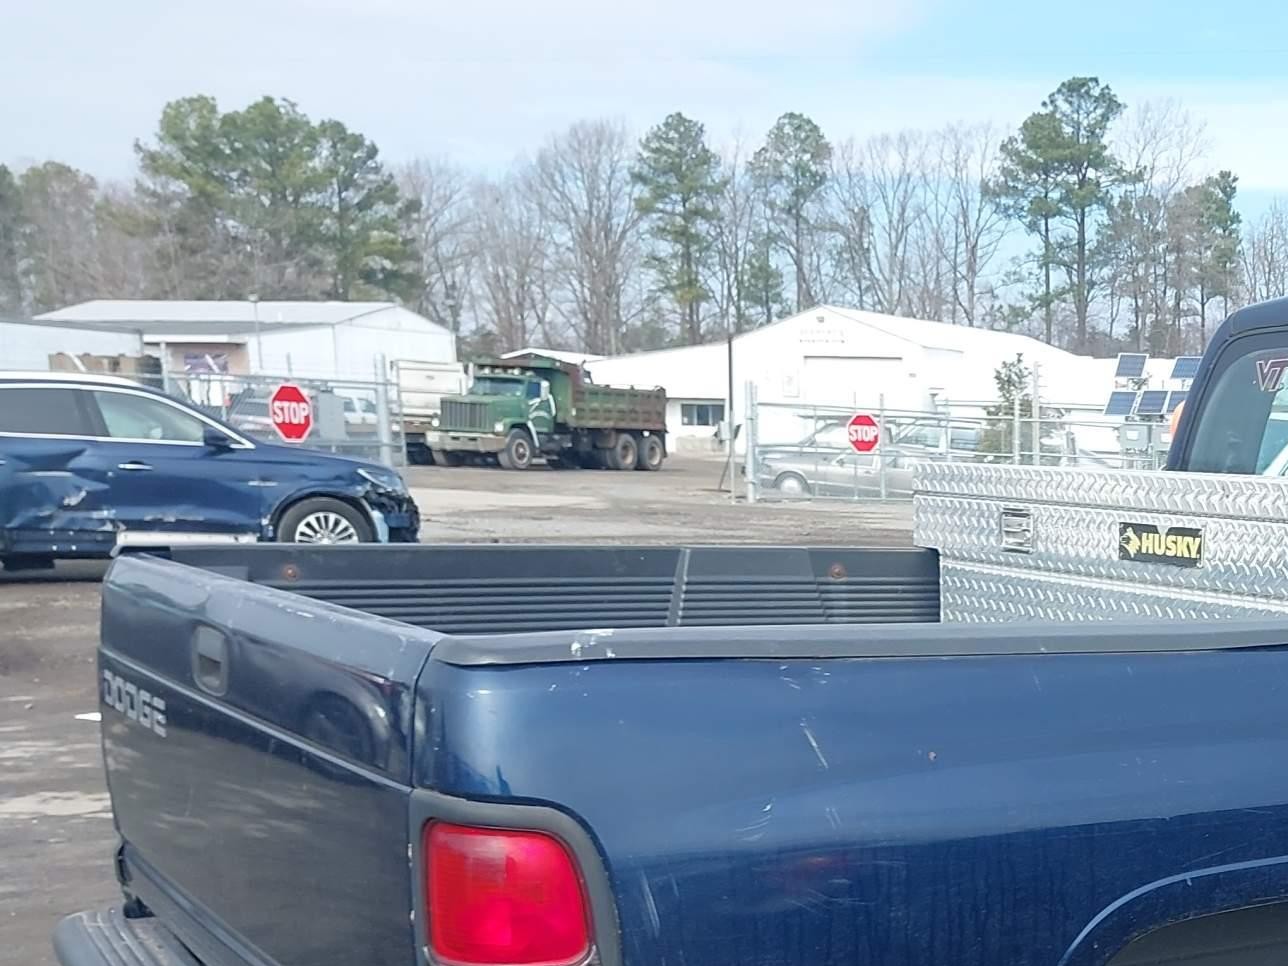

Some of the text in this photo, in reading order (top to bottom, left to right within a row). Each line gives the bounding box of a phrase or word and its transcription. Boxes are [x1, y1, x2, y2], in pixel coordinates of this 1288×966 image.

[273, 400, 309, 425] STOP
[849, 425, 878, 442] STOP
[103, 670, 167, 738] DODGE
